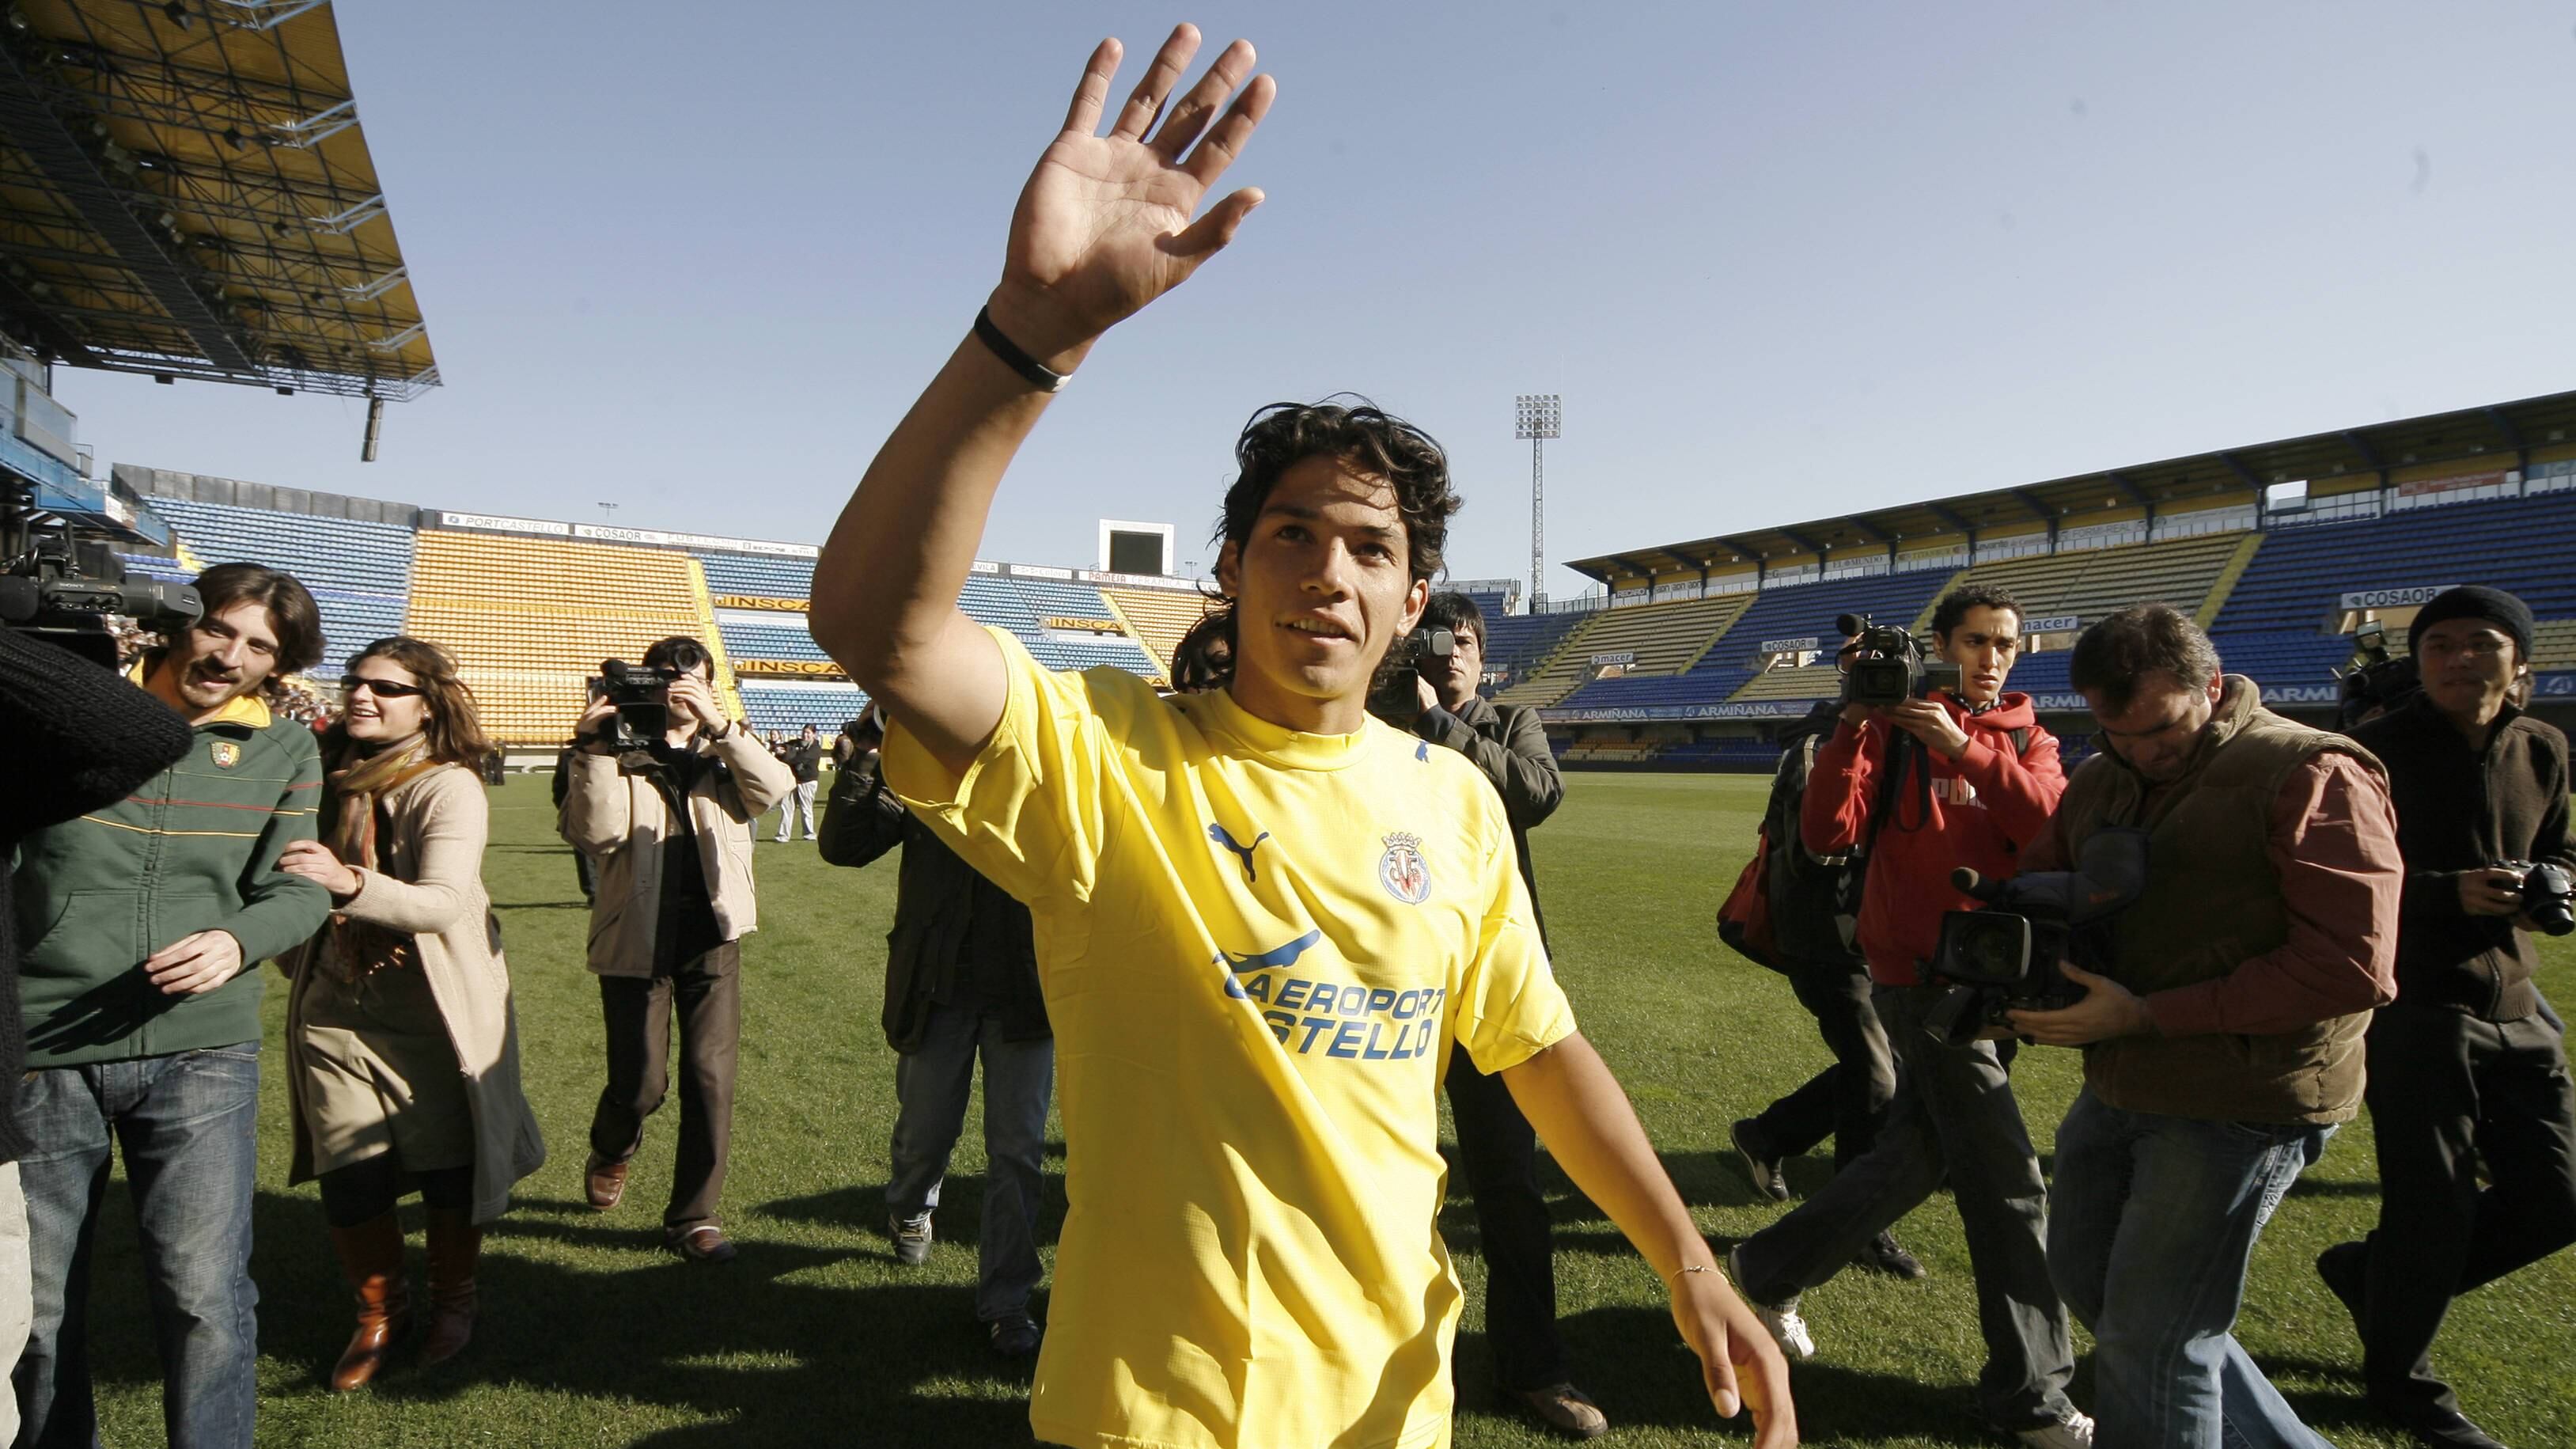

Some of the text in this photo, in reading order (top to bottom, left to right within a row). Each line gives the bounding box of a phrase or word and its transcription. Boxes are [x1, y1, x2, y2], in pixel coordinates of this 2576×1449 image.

[465, 517, 563, 534] PORTCASTELLO
[595, 527, 641, 541] COSAOR
[1089, 571, 1126, 583] PAMESA
[2364, 588, 2436, 606] COSAOR
[1054, 617, 1122, 631] INSCA
[1772, 639, 1806, 651] COSAOR
[1601, 654, 1631, 662] macer
[751, 660, 846, 673] INSCA
[1582, 707, 1648, 719] ARMIÑANA
[1698, 704, 1779, 716] ARMIÑANA
[1244, 973, 1446, 1019] AEROPORT
